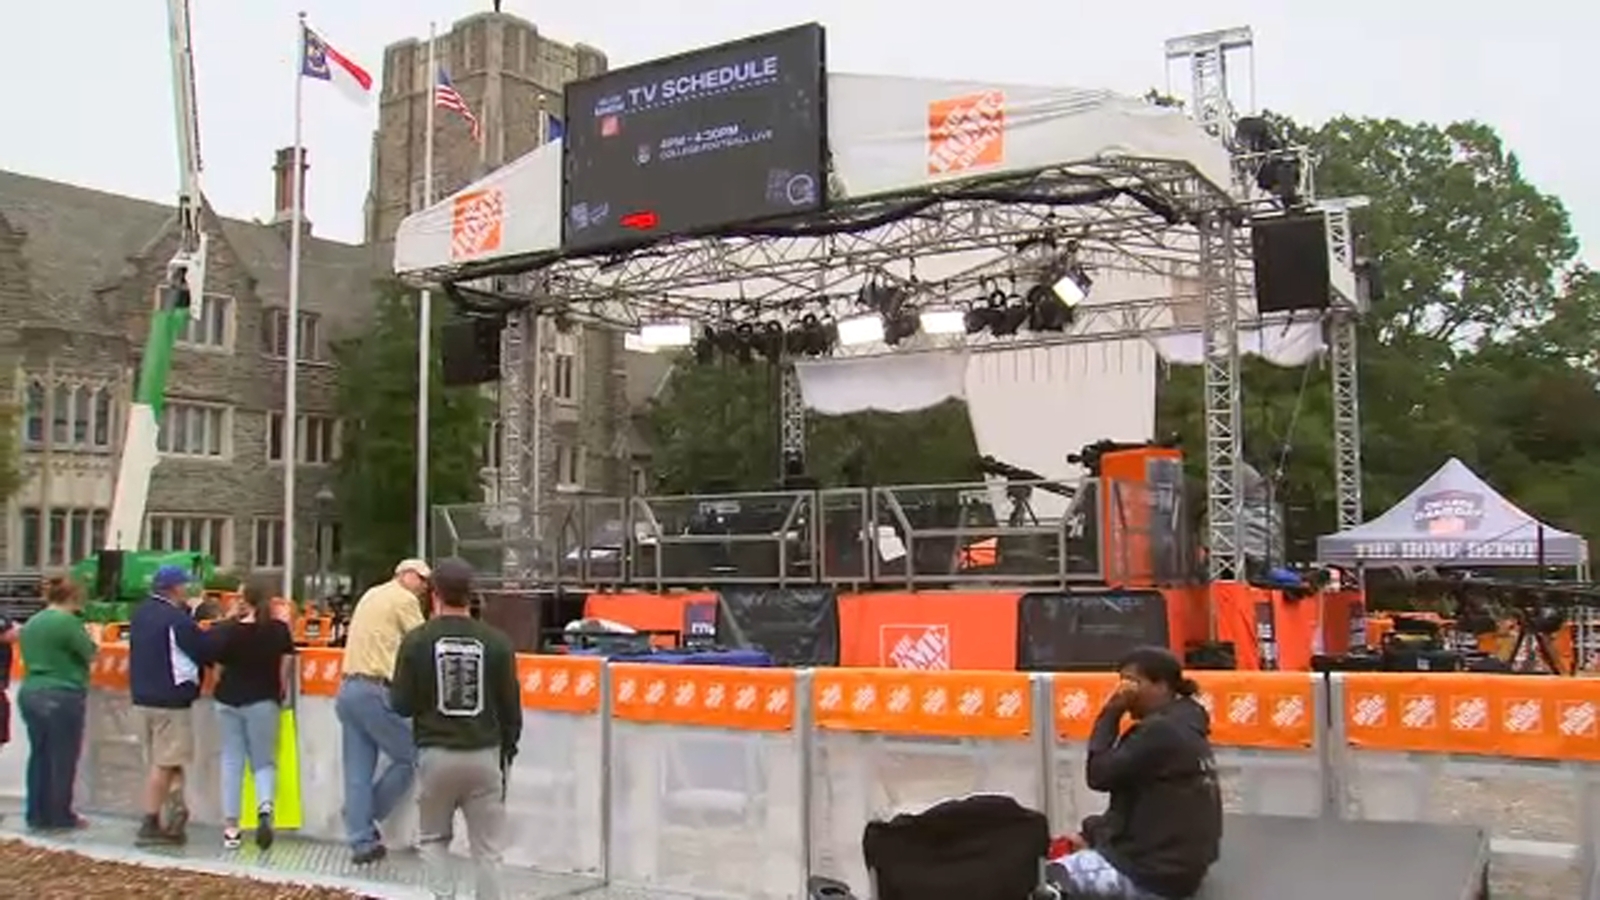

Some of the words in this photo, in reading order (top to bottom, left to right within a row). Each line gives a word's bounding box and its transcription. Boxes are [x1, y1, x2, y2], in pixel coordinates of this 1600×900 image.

[628, 84, 657, 105] TV
[662, 56, 778, 98] SCHEDULE
[752, 130, 773, 141] LIVE
[1353, 541, 1398, 559] THE
[1401, 541, 1461, 559] HOME
